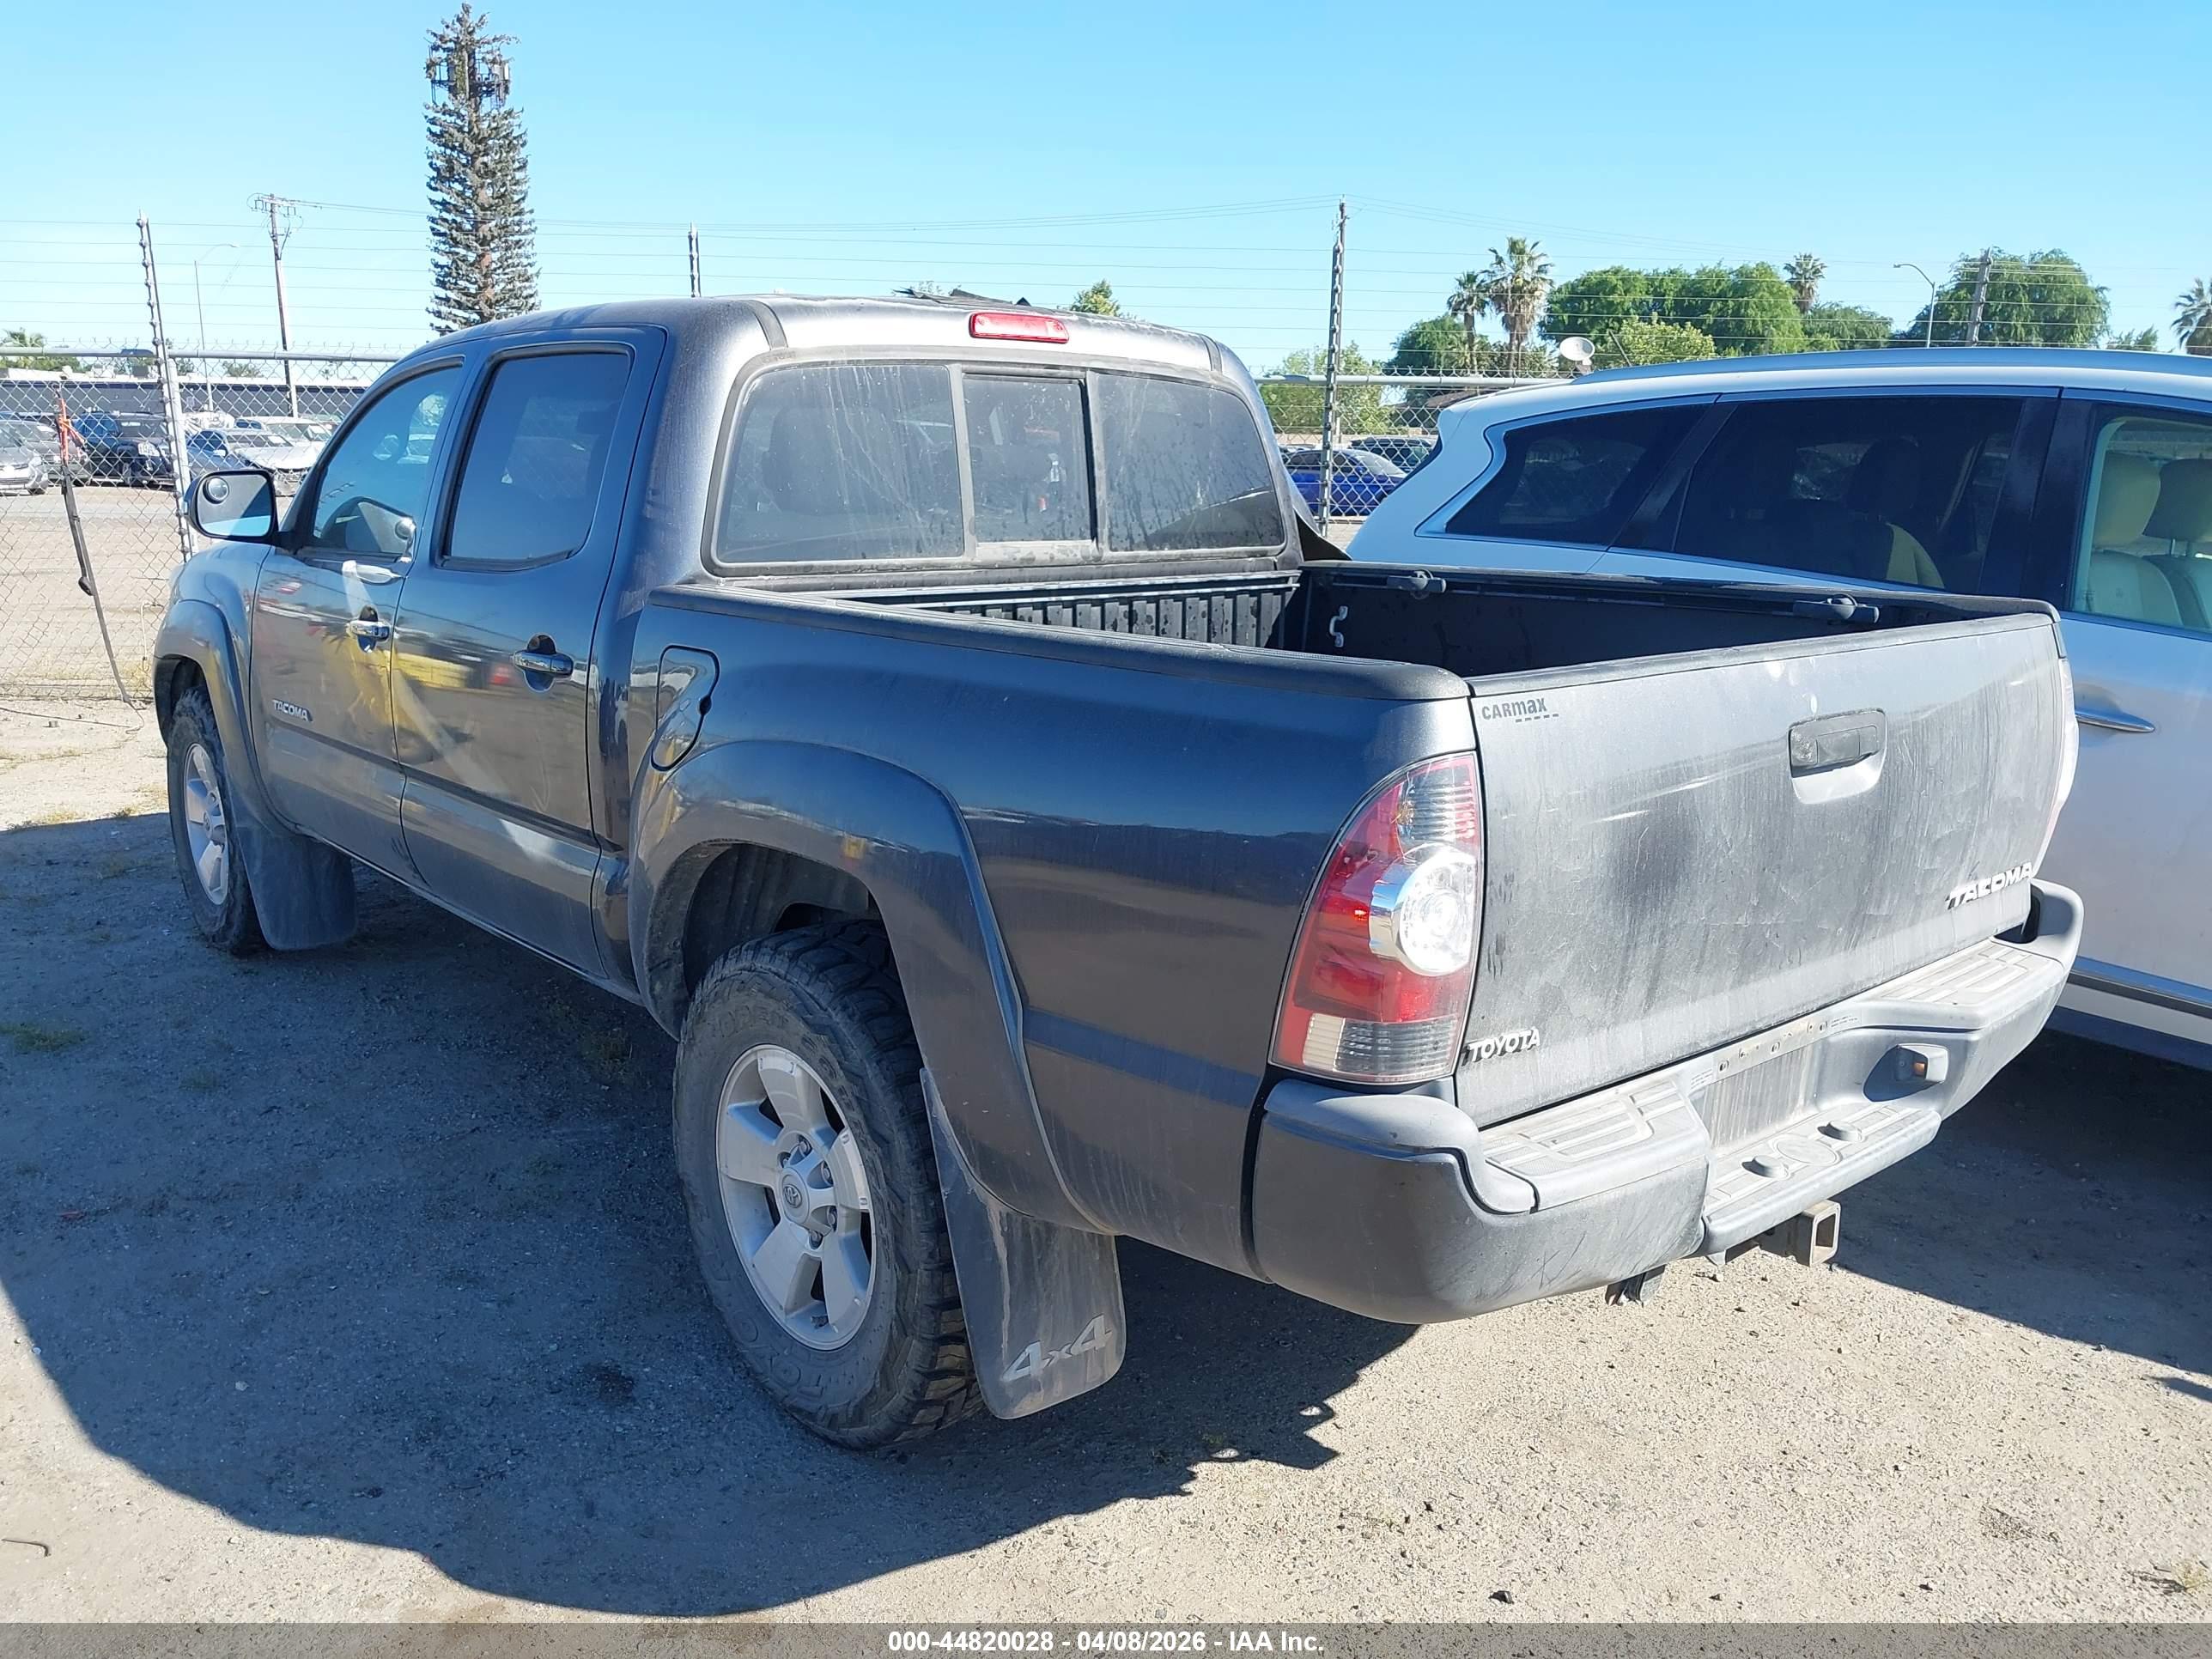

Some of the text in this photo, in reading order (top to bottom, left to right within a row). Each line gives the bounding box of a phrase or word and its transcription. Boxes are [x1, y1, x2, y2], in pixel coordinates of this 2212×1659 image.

[271, 698, 311, 722] TACOMA
[1945, 861, 2033, 910] TACOMA
[1467, 1026, 1540, 1063] TOYOTA
[1000, 1314, 1114, 1382] 4x4
